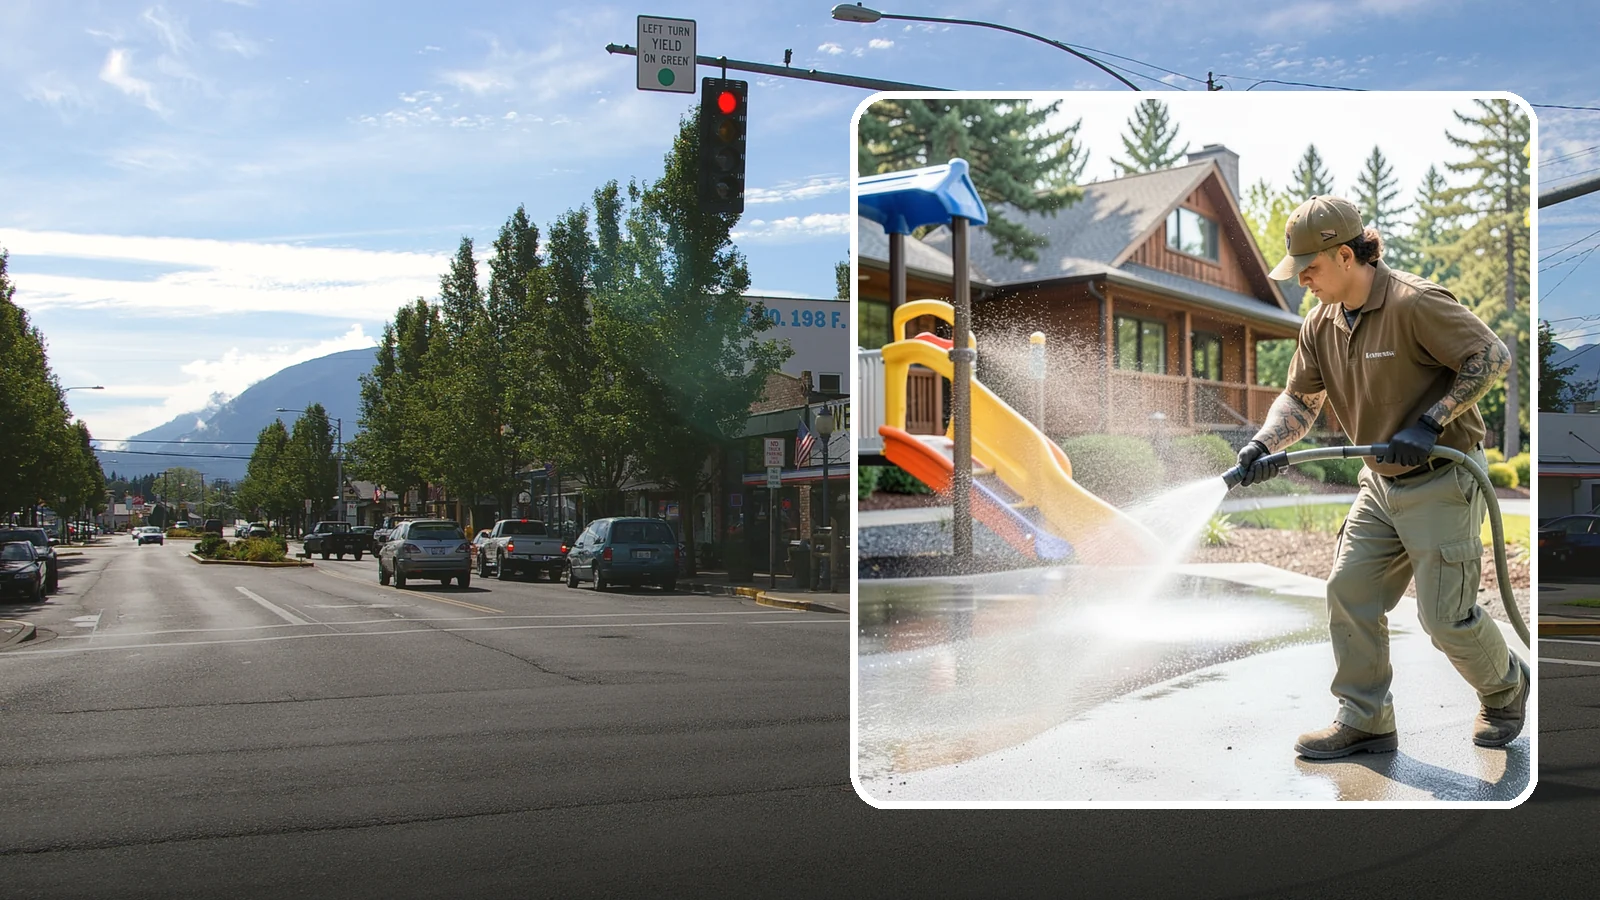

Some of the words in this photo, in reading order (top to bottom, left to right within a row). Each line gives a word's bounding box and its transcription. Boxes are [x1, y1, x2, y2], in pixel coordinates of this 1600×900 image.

[643, 23, 663, 34] LEFT
[668, 25, 690, 36] TURN
[652, 38, 682, 52] YIELD
[791, 309, 826, 328] 198
[831, 311, 847, 329] F.
